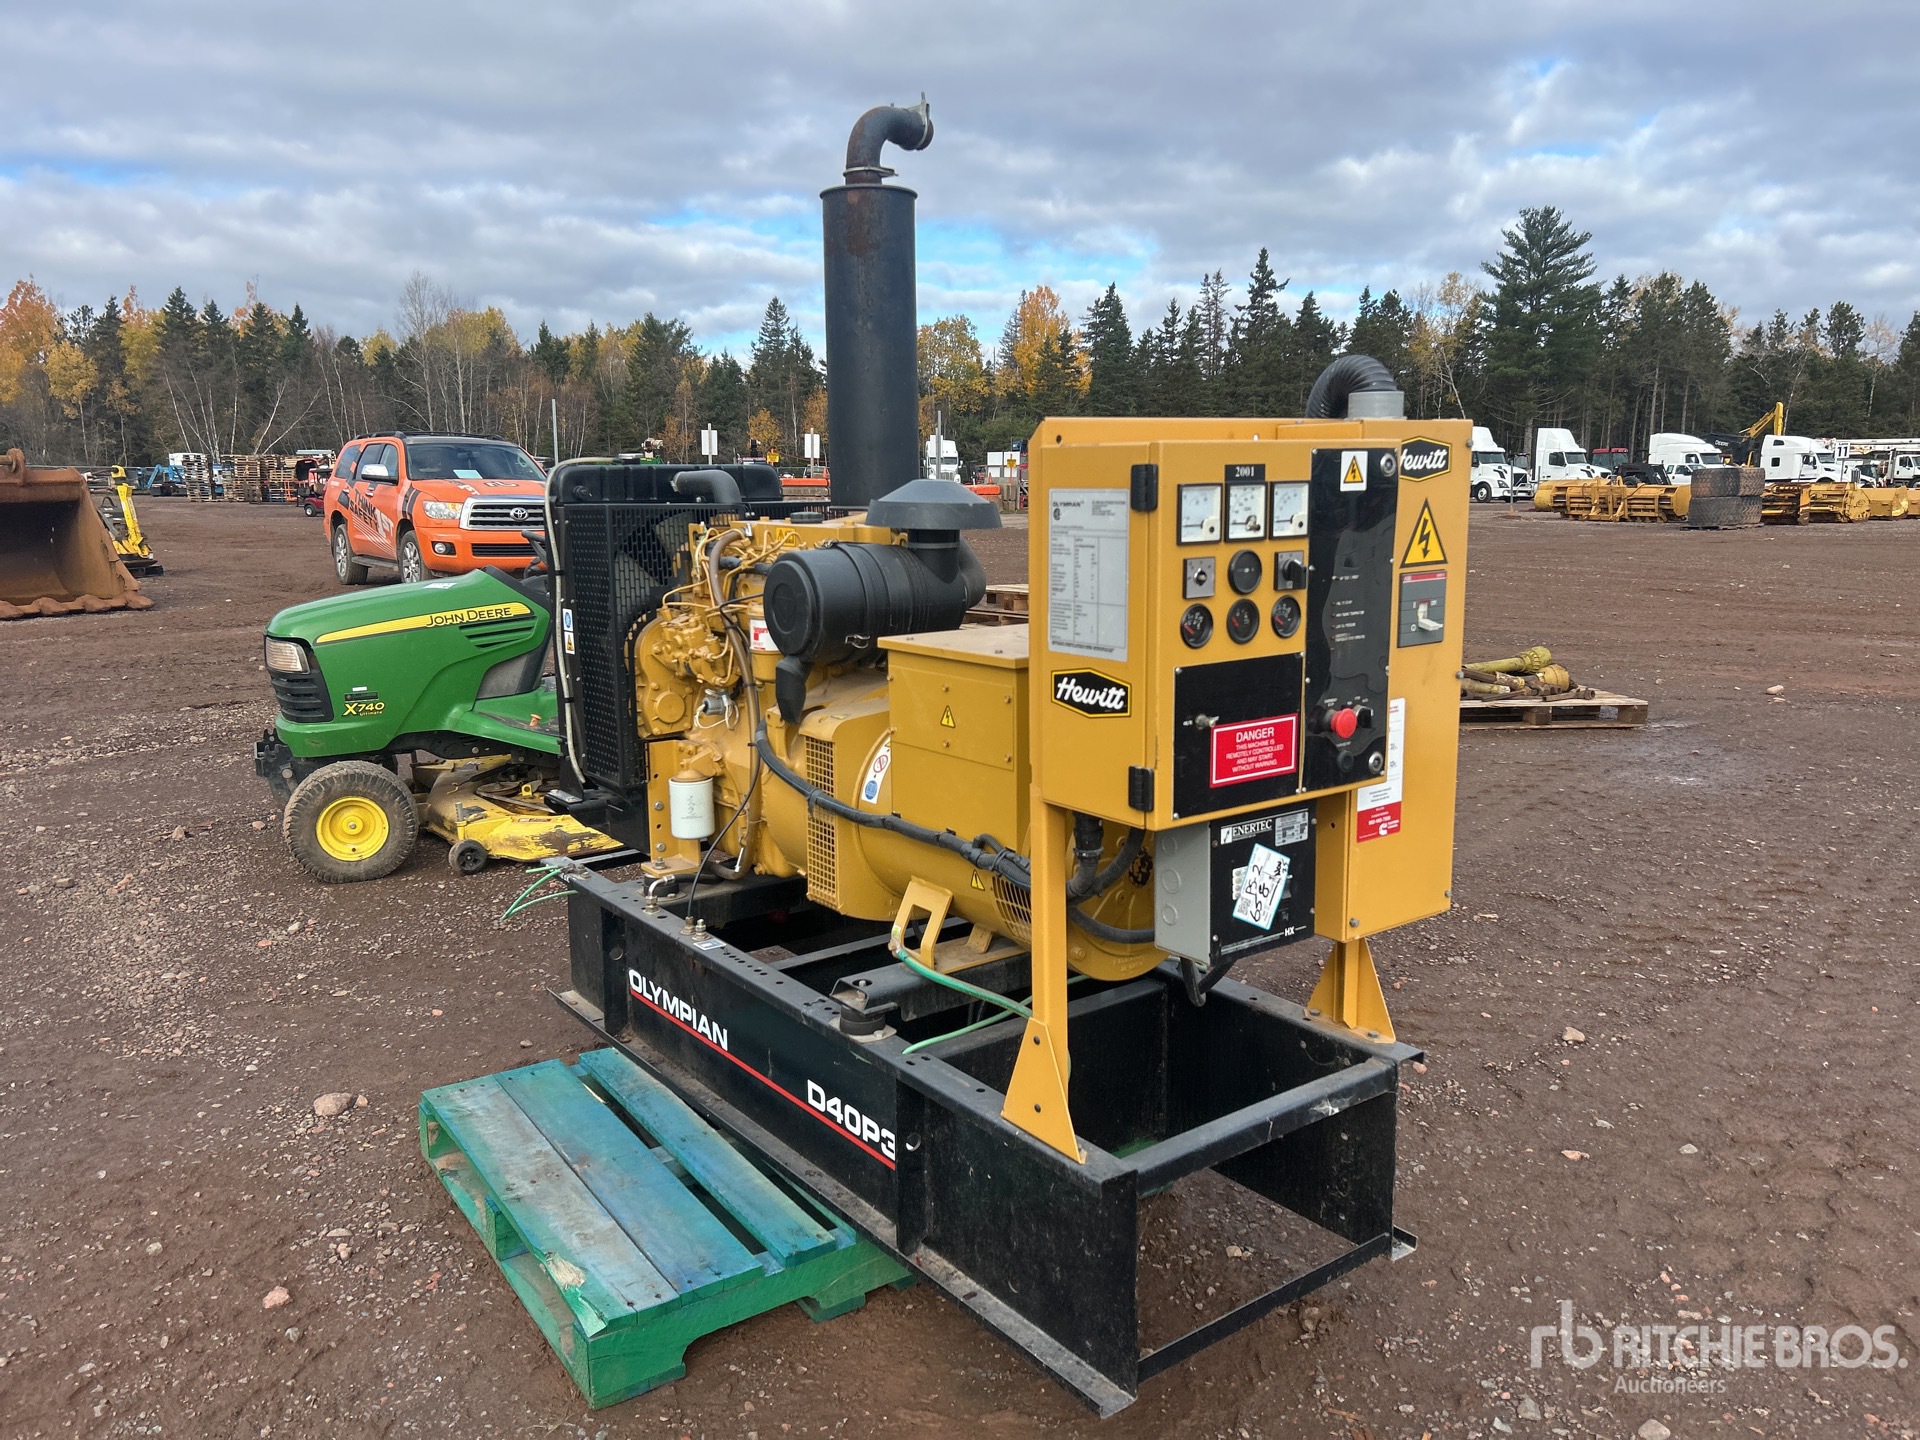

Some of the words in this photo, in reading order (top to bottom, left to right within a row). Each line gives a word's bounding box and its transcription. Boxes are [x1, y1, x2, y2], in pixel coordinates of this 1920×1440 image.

[1837, 446, 1849, 457] 11
[1234, 465, 1255, 478] 2001
[355, 489, 377, 520] THINK
[349, 500, 379, 531] SAFETY
[374, 507, 395, 539] 1ST
[426, 613, 464, 627] JOHN
[467, 607, 512, 621] DEERE
[1056, 676, 1126, 710] Hewitt
[342, 702, 385, 716] X740
[1236, 727, 1275, 743] DANGER
[1226, 750, 1252, 760] REMOTELY
[1251, 743, 1284, 755] CONTROLLED
[1236, 743, 1248, 751] THIS
[1247, 740, 1269, 749] MACHINE
[1257, 753, 1274, 761] START
[1232, 763, 1255, 773] WITHOUT
[1254, 759, 1278, 769] WARNING
[1232, 819, 1273, 837] ENERTEC
[1284, 926, 1295, 937] HX
[628, 969, 728, 1052] OLYMPIAN
[807, 1079, 896, 1162] D40P3
